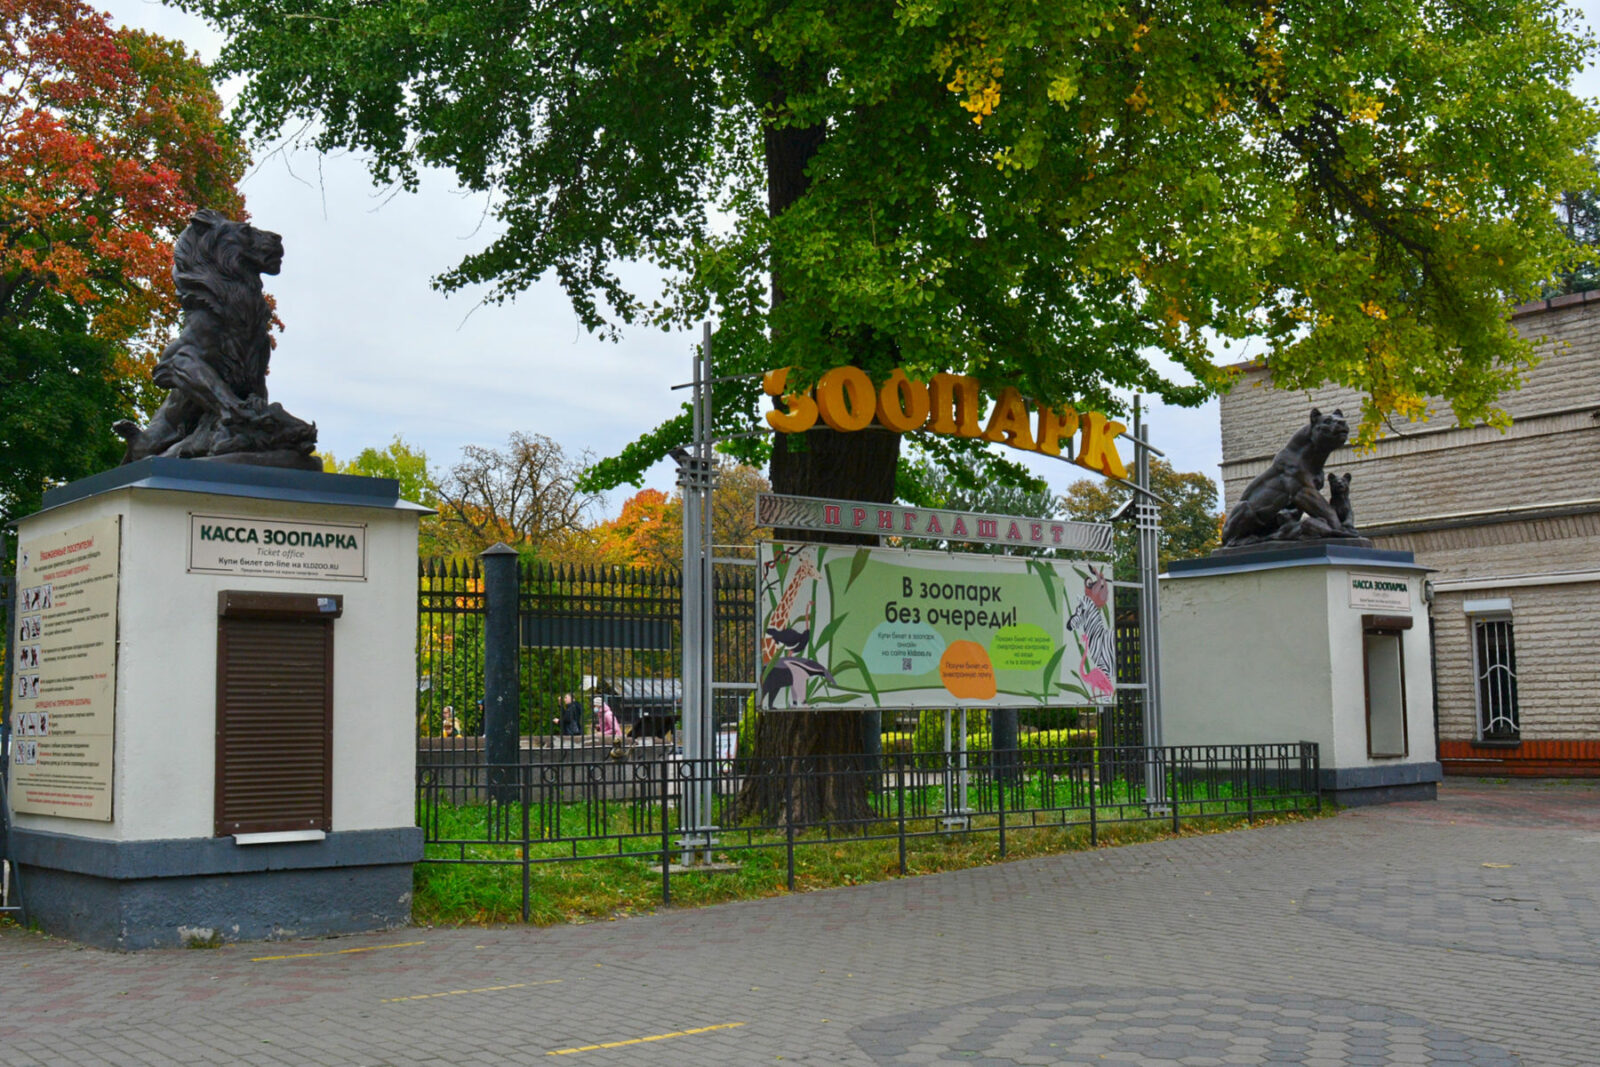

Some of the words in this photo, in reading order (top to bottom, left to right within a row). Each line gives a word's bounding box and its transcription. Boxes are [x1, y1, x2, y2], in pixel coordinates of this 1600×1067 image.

[763, 366, 1129, 480] ЗООПАРК
[823, 504, 1064, 543] ПРИГЛАШАЕТ
[200, 525, 259, 544] КАССА
[263, 529, 358, 549] ЗООПАРКА
[218, 557, 238, 566] Купи
[240, 558, 263, 567] билет
[265, 559, 290, 568] on-line
[303, 563, 339, 571] KLDZOO.RU
[257, 547, 281, 557] Ticket
[281, 548, 305, 558] office
[902, 576, 913, 598] В
[919, 580, 1001, 606] зоопарк
[1352, 579, 1373, 589] КАССА
[1374, 581, 1407, 592] ЗООПАРКА
[885, 601, 920, 624] без
[927, 607, 1017, 630] очереди!
